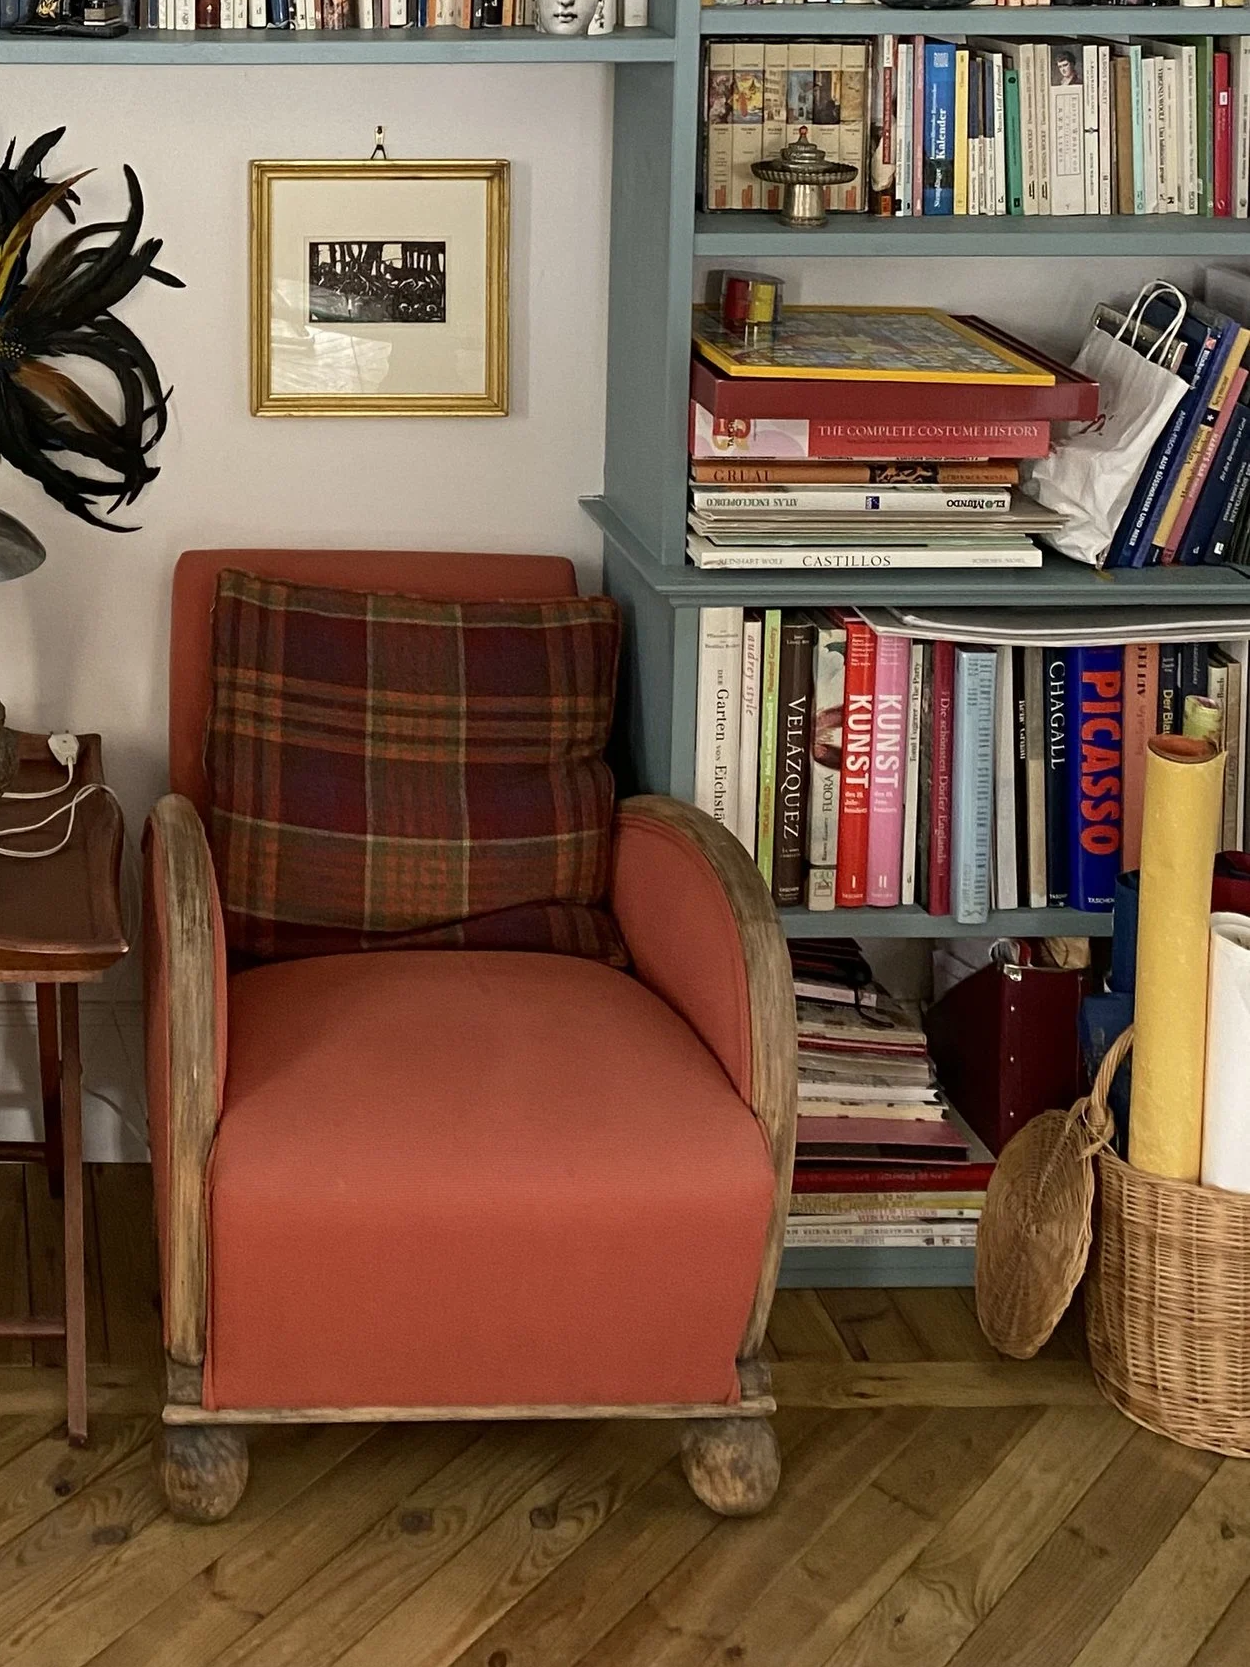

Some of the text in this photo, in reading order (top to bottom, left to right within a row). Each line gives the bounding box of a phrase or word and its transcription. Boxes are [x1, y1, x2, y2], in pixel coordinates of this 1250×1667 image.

[936, 108, 946, 160] Kalender
[818, 425, 1038, 438] THE COMPLETE COSTUME HISTORY
[947, 500, 985, 509] MUNDO
[802, 554, 891, 568] CASTILLOS
[745, 635, 758, 716] audrey style
[714, 688, 728, 741] Garten
[845, 694, 873, 789] KUNST
[875, 694, 903, 789] KUNST
[1049, 660, 1066, 770] CHAGALL
[782, 695, 807, 840] VELÁZQUEZ
[820, 775, 834, 813] FLORA
[1080, 669, 1122, 855] PICASSO
